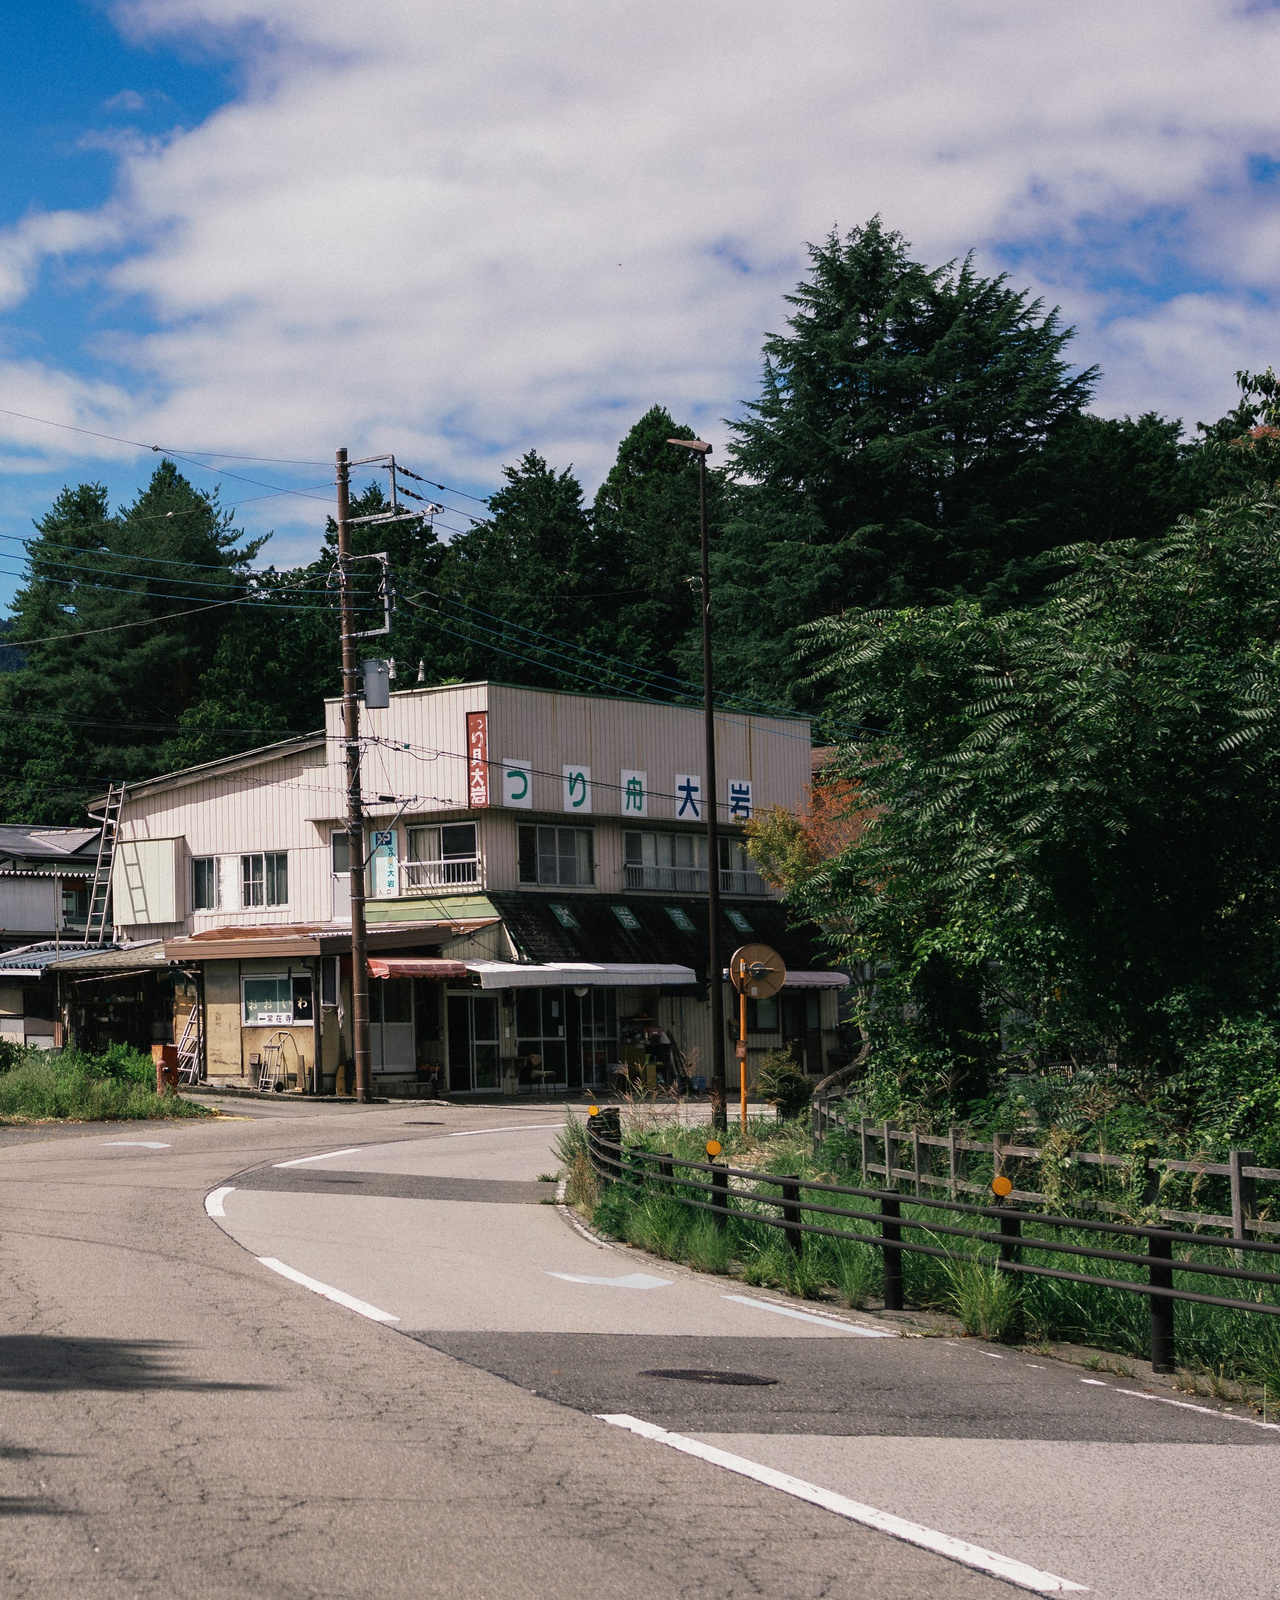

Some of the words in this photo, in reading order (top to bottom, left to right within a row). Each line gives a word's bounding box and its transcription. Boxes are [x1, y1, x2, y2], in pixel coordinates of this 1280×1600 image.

[506, 770, 751, 820] つり舟大岩
